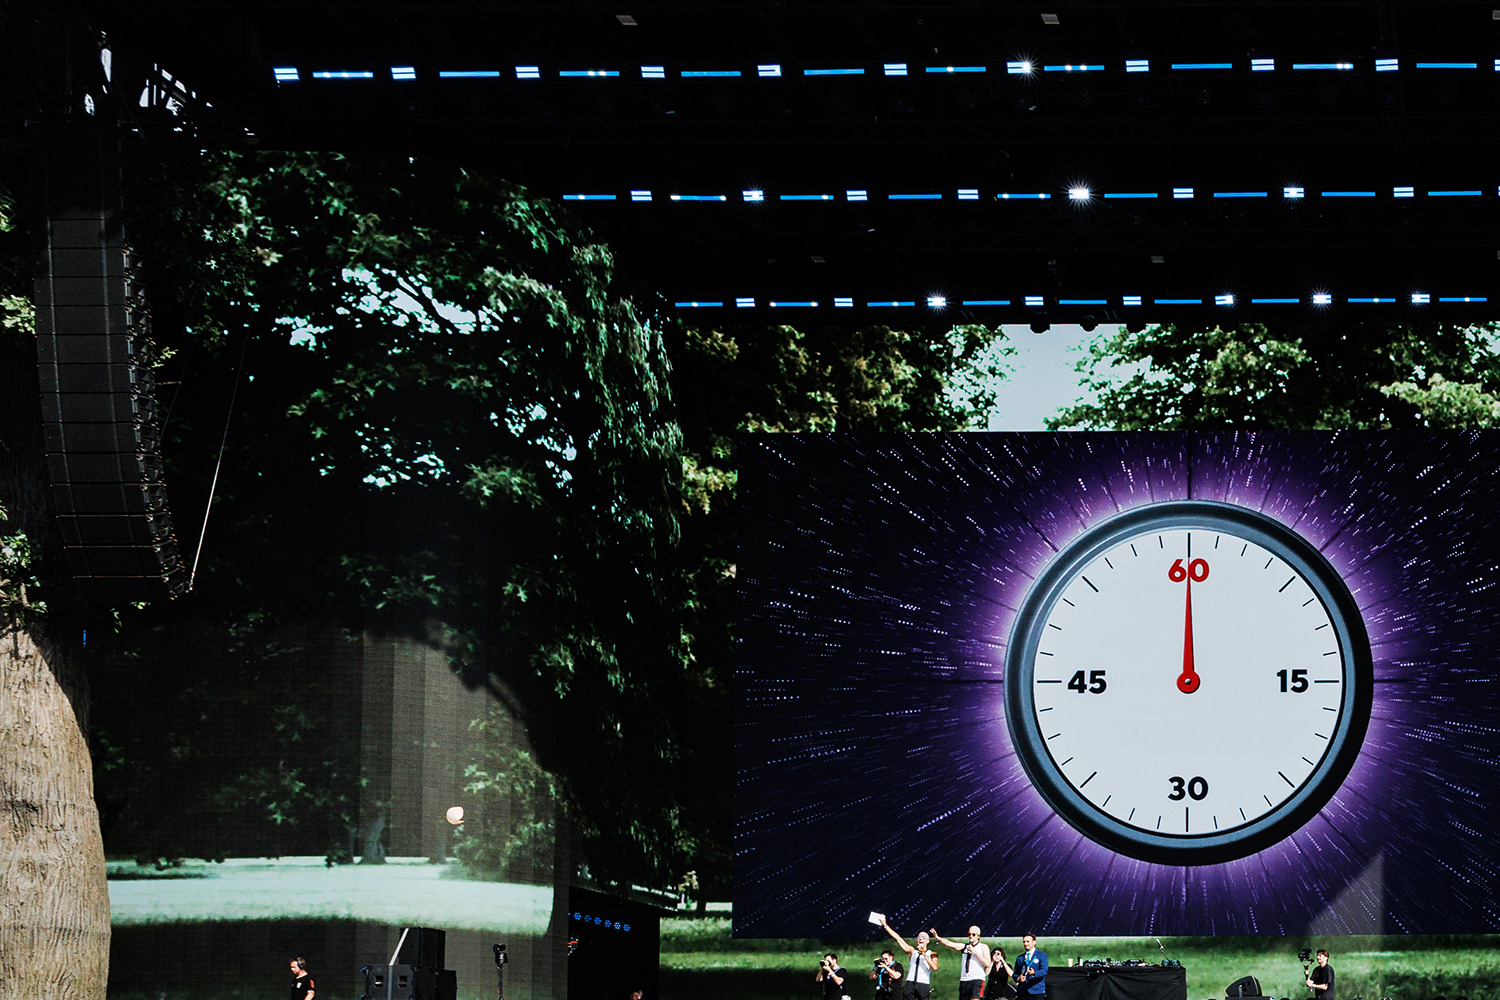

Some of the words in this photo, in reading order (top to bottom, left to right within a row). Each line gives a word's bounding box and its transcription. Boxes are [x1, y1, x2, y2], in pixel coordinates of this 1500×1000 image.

[1168, 558, 1210, 583] 60
[1067, 669, 1107, 694] 45
[1276, 669, 1309, 693] 15
[1167, 776, 1209, 801] 30
